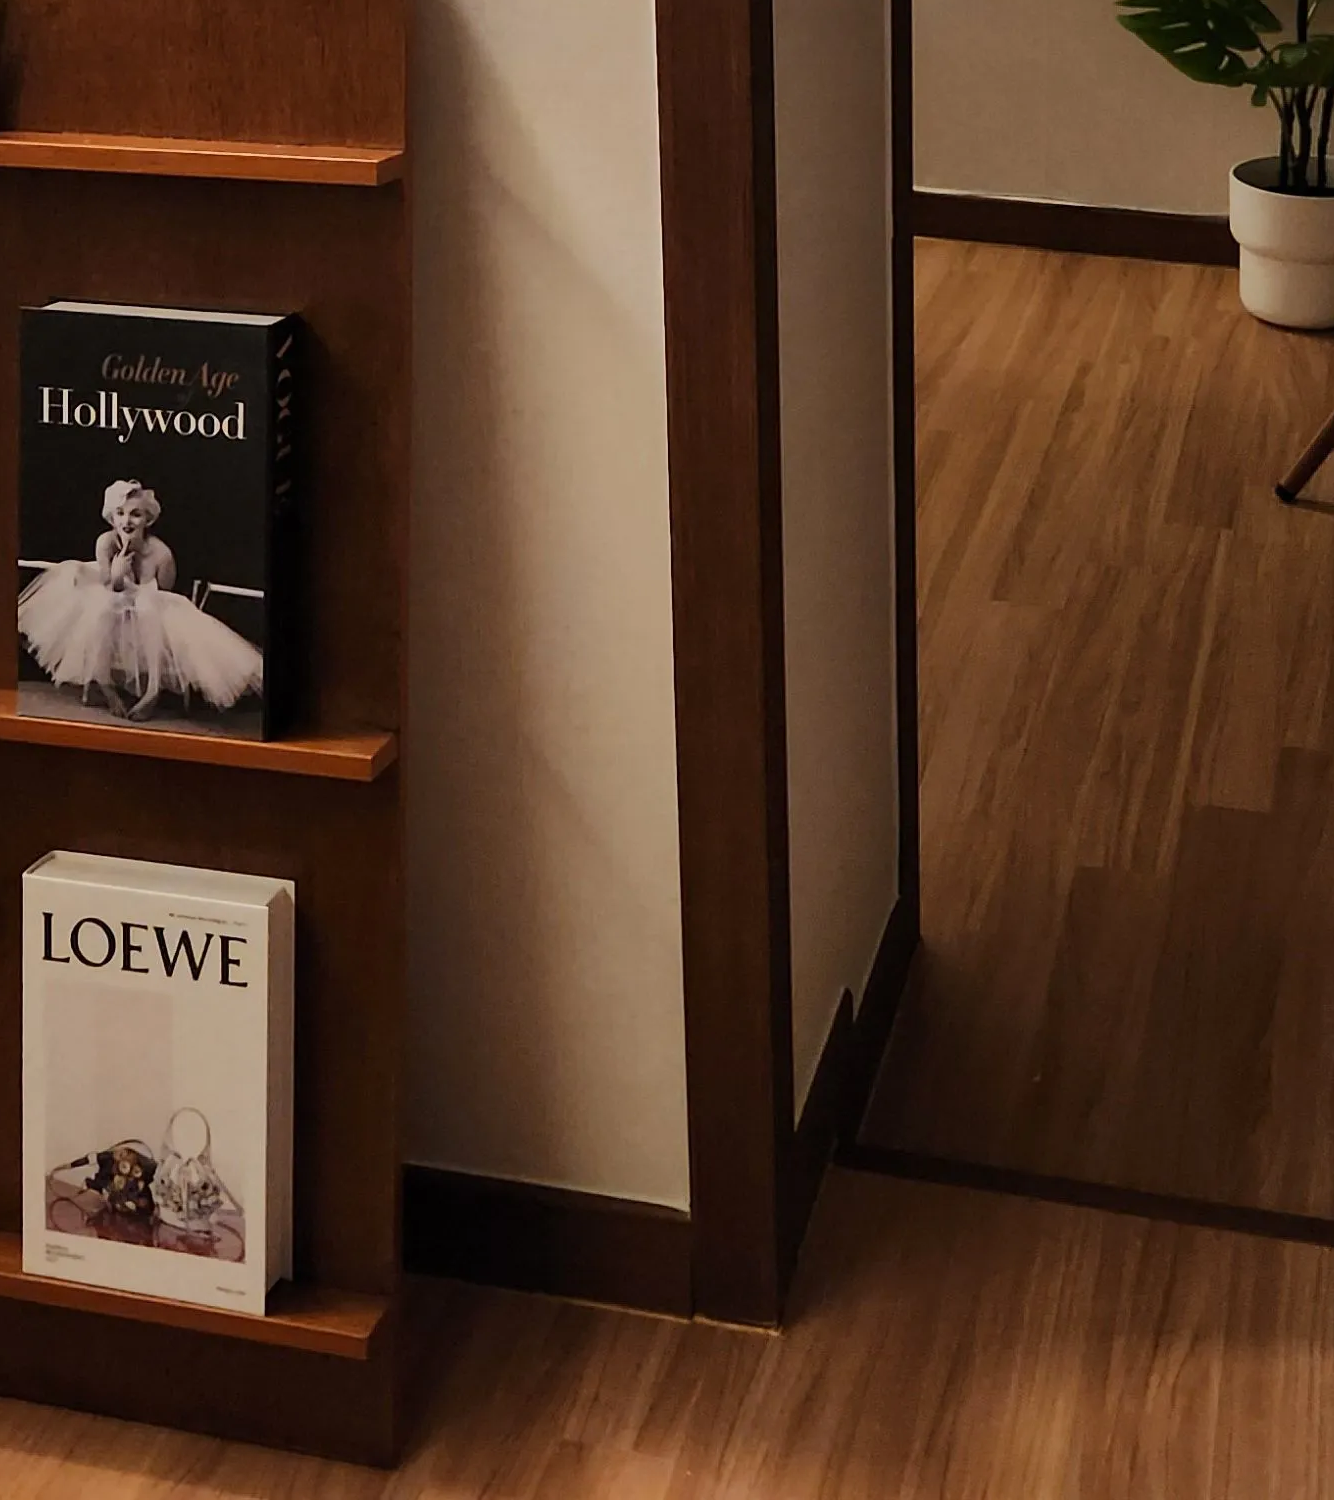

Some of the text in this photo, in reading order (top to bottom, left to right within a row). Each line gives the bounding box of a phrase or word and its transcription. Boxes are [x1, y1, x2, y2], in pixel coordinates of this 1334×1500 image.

[101, 353, 240, 397] Golden Age
[39, 386, 247, 443] Hollywood
[41, 911, 248, 988] LOEWE
